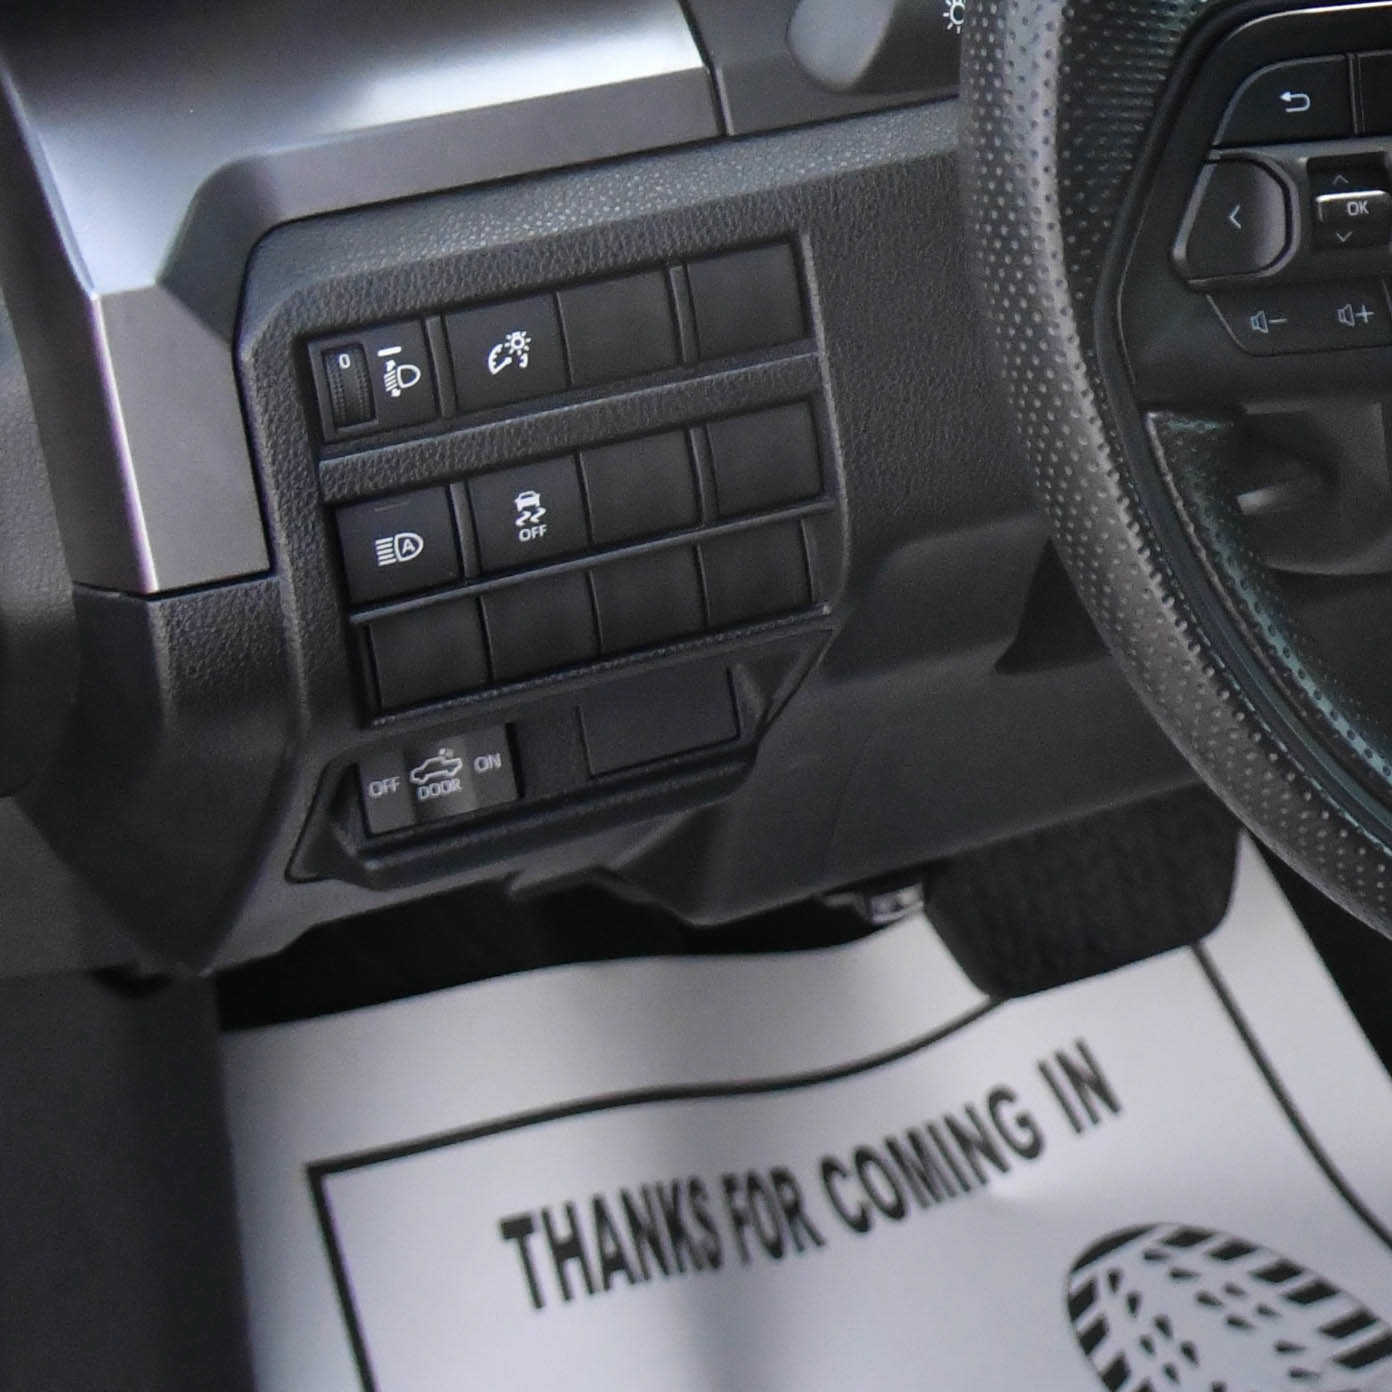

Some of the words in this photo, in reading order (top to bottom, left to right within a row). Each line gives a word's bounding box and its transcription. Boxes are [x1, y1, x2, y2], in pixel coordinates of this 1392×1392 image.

[1346, 199, 1369, 217] OK
[518, 524, 548, 543] OFF
[473, 752, 502, 773] ON
[368, 776, 400, 798] OFF
[417, 778, 464, 801] DOOR
[499, 1174, 724, 1312] THANKS
[722, 1165, 828, 1268] FOR
[819, 1083, 1046, 1236] COMING
[1036, 1037, 1124, 1136] IN
